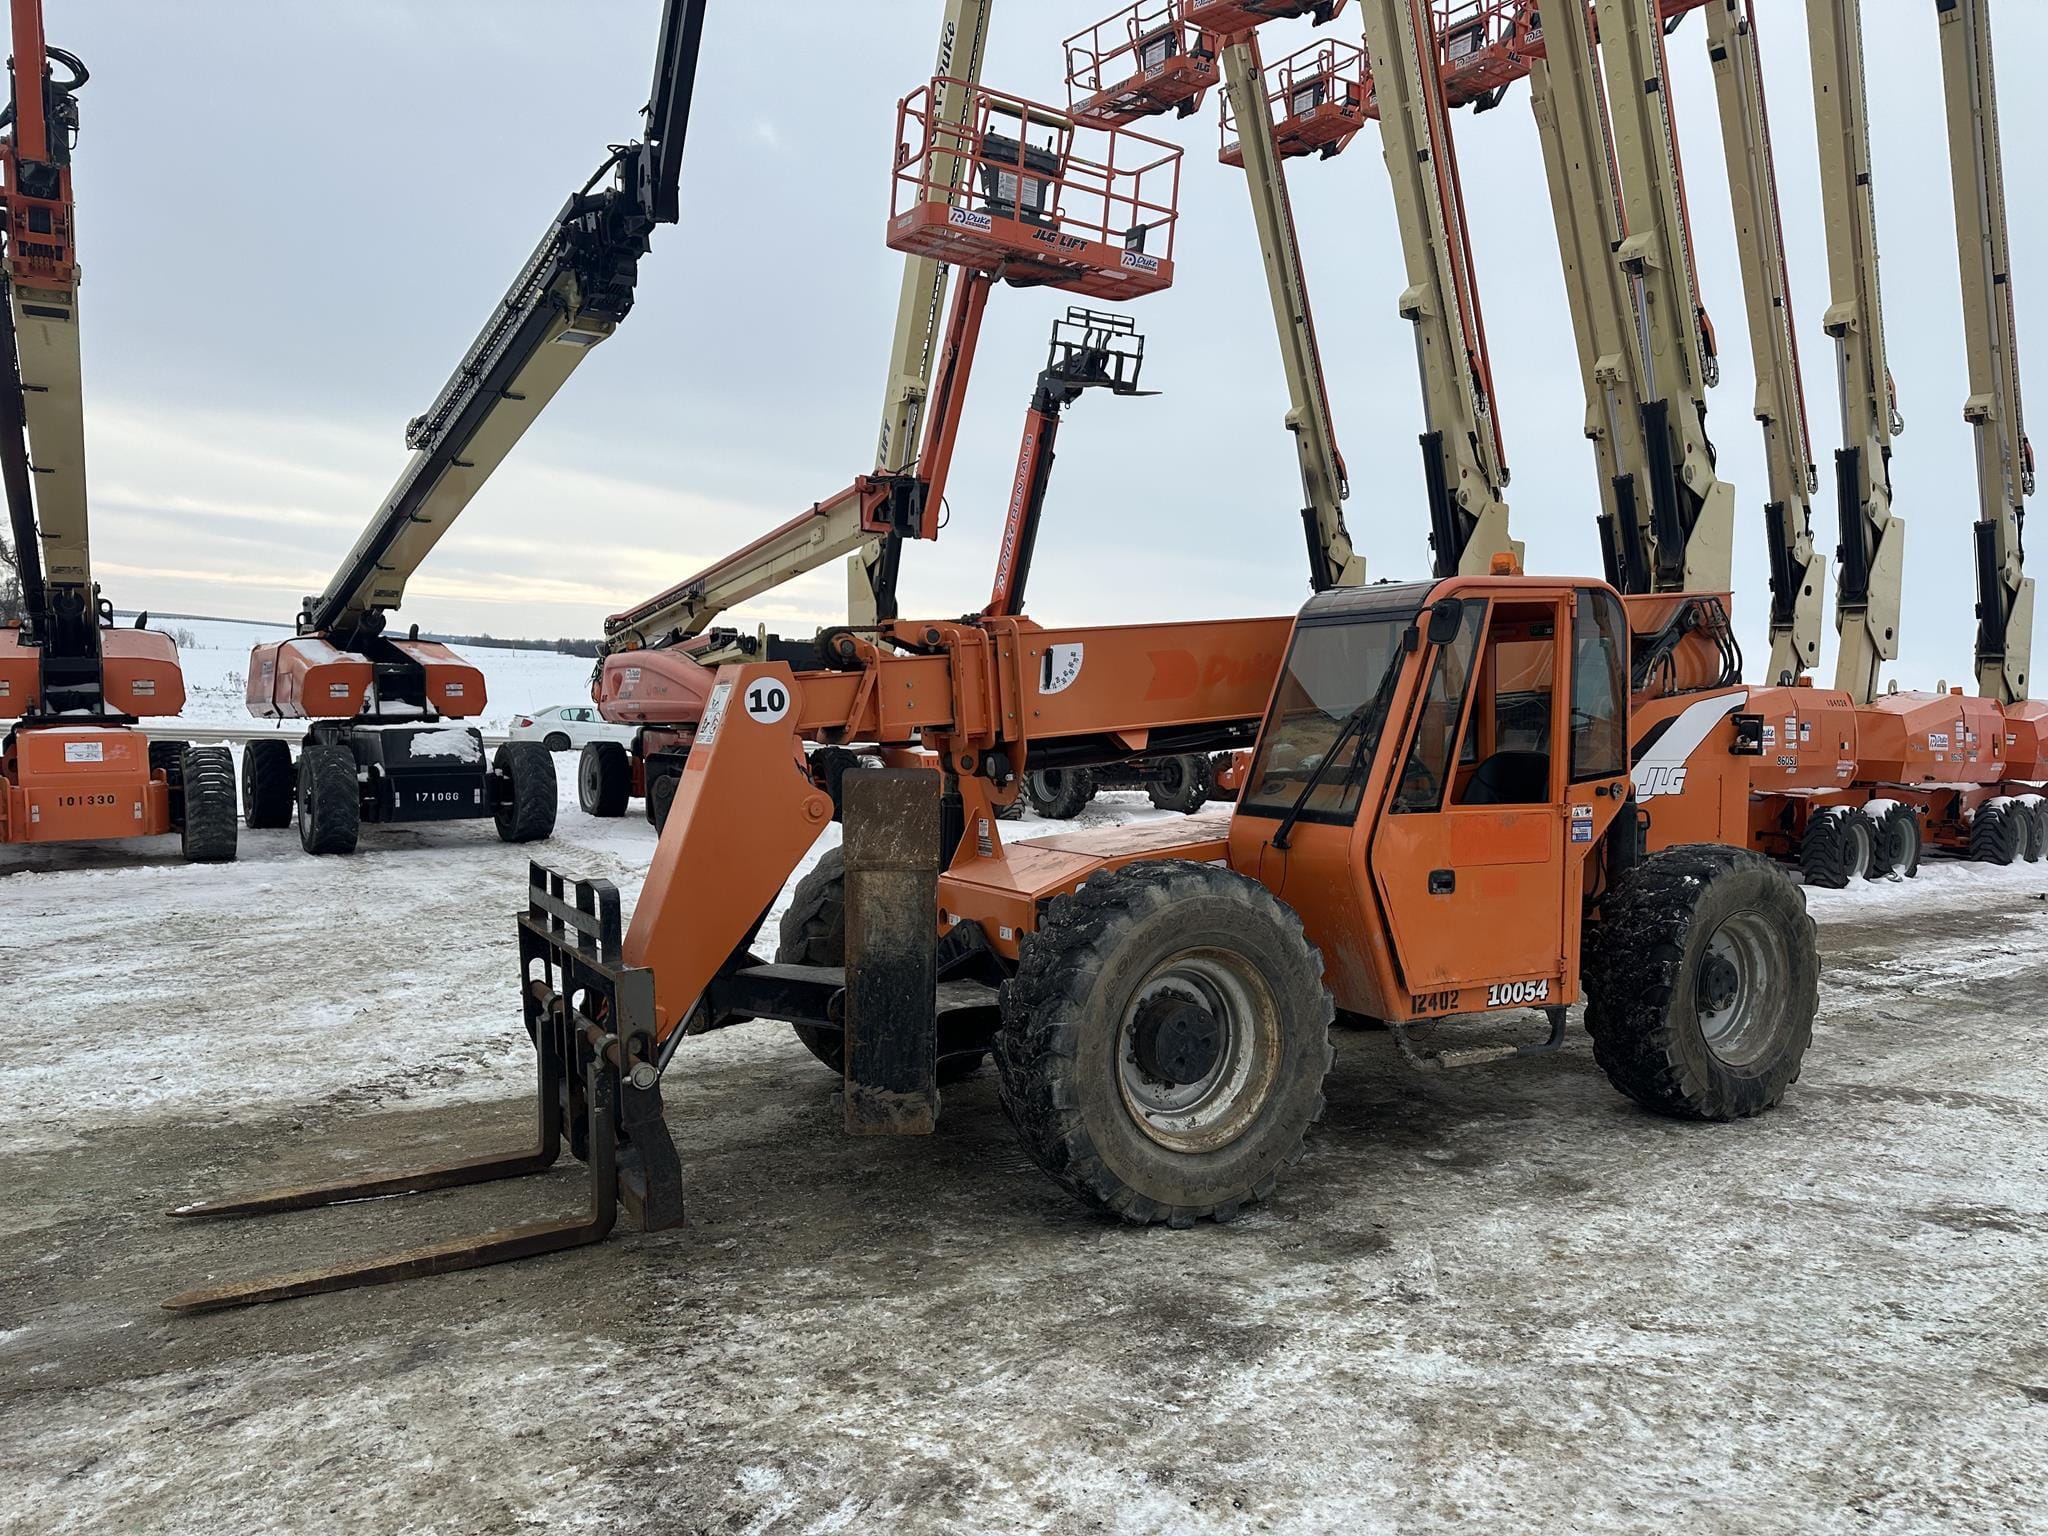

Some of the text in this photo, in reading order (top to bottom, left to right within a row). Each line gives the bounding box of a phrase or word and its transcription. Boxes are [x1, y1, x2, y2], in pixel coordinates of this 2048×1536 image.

[1193, 62, 1211, 73] JLG
[1339, 108, 1355, 118] JLG
[967, 213, 991, 225] Duke
[1032, 229, 1057, 243] JLG
[1059, 235, 1088, 251] LIFT
[1137, 256, 1157, 268] Duke
[1011, 433, 1033, 521] RENTALS
[749, 688, 785, 713] 10
[1637, 767, 1688, 796] JLG
[59, 795, 115, 806] 101330
[1411, 990, 1459, 1014] 12402
[1486, 978, 1550, 1007] 10054
